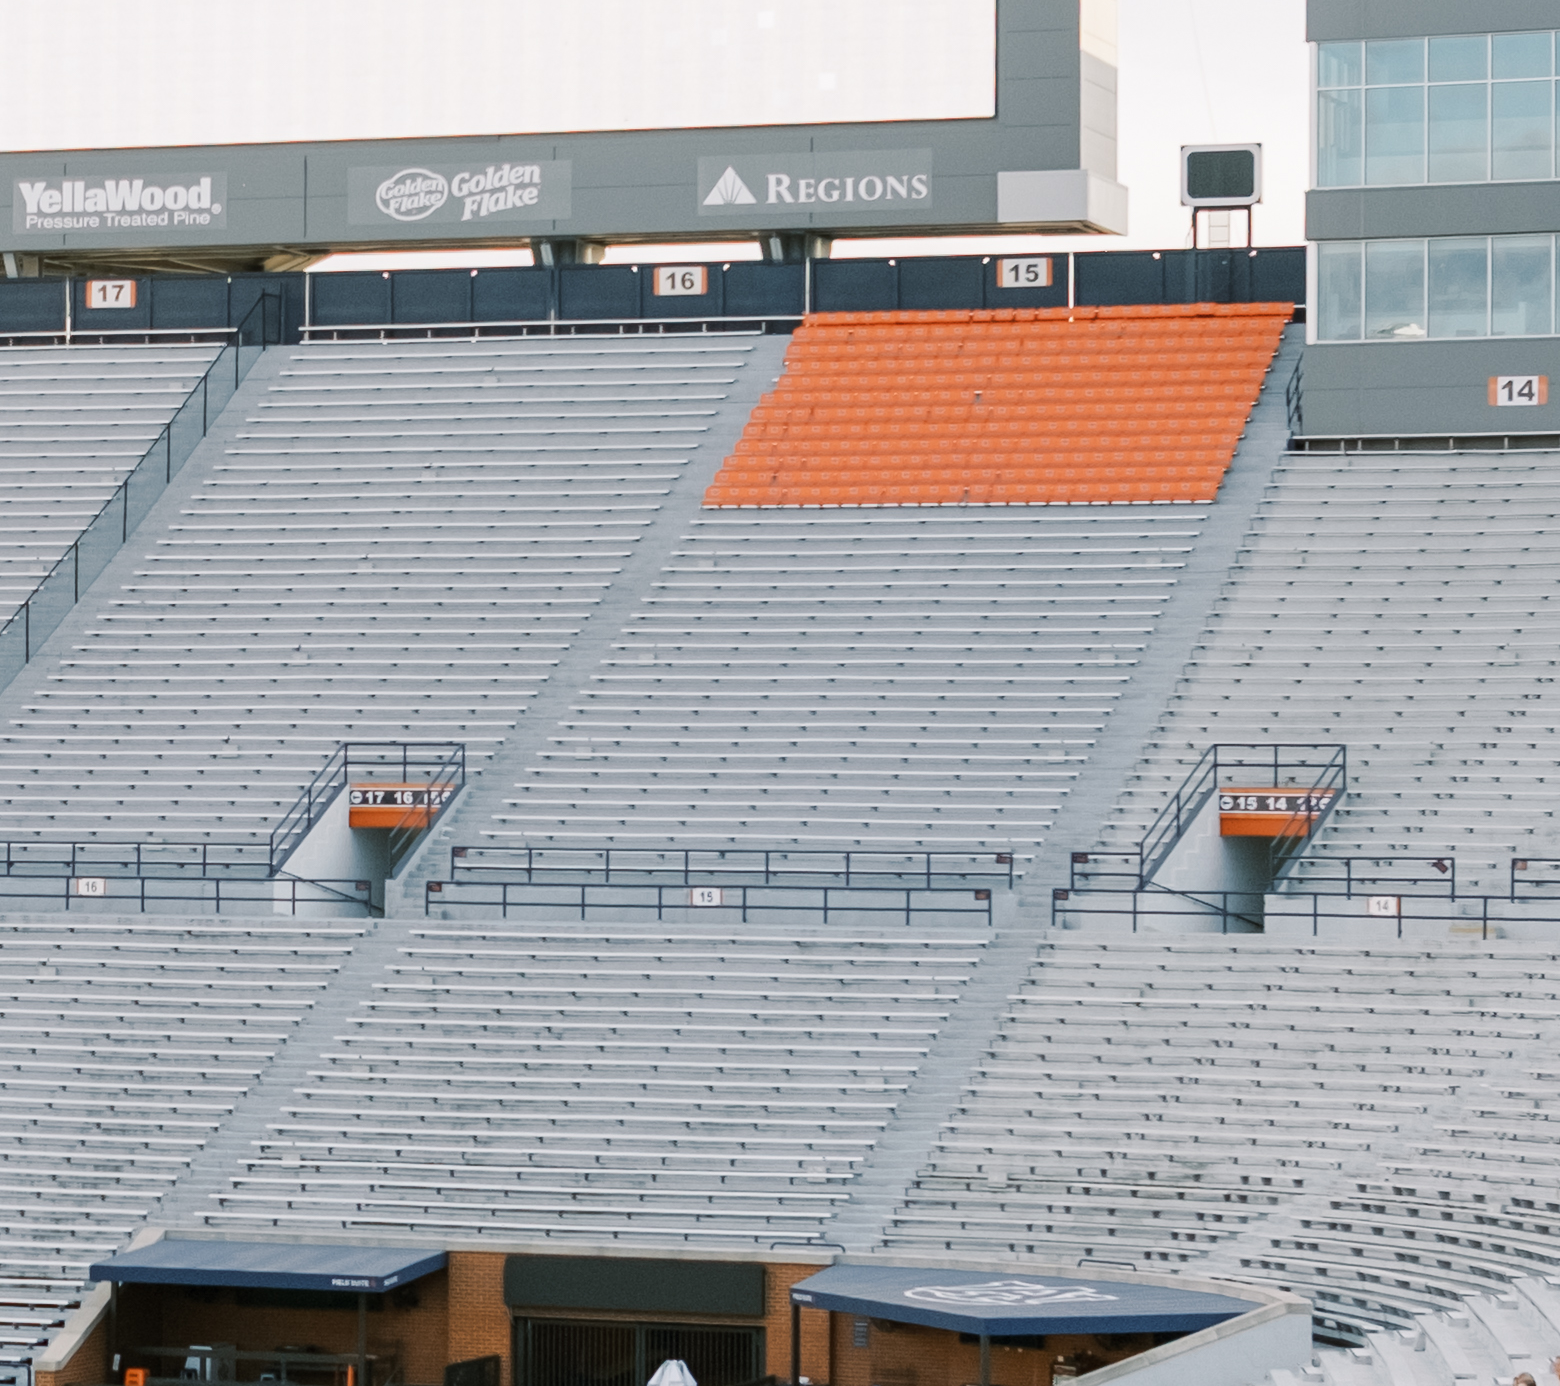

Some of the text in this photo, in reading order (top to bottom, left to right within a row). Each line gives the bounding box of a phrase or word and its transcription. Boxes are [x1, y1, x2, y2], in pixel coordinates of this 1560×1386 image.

[381, 177, 444, 201] Golden
[451, 164, 541, 198] Golden
[766, 172, 929, 206] REGIONS
[389, 191, 442, 213] Flake
[461, 186, 540, 221] Flake
[26, 211, 210, 229] Pressure Treated Pine
[666, 272, 694, 291] 16
[1009, 263, 1038, 284] 15
[98, 285, 124, 302] 17
[1502, 380, 1535, 401] 14
[366, 791, 385, 804] 17
[394, 791, 413, 804] 16
[1236, 797, 1257, 811] 15
[1266, 797, 1287, 811] 14
[85, 882, 97, 893] 16
[700, 891, 713, 903] 15
[1376, 900, 1389, 912] 14
